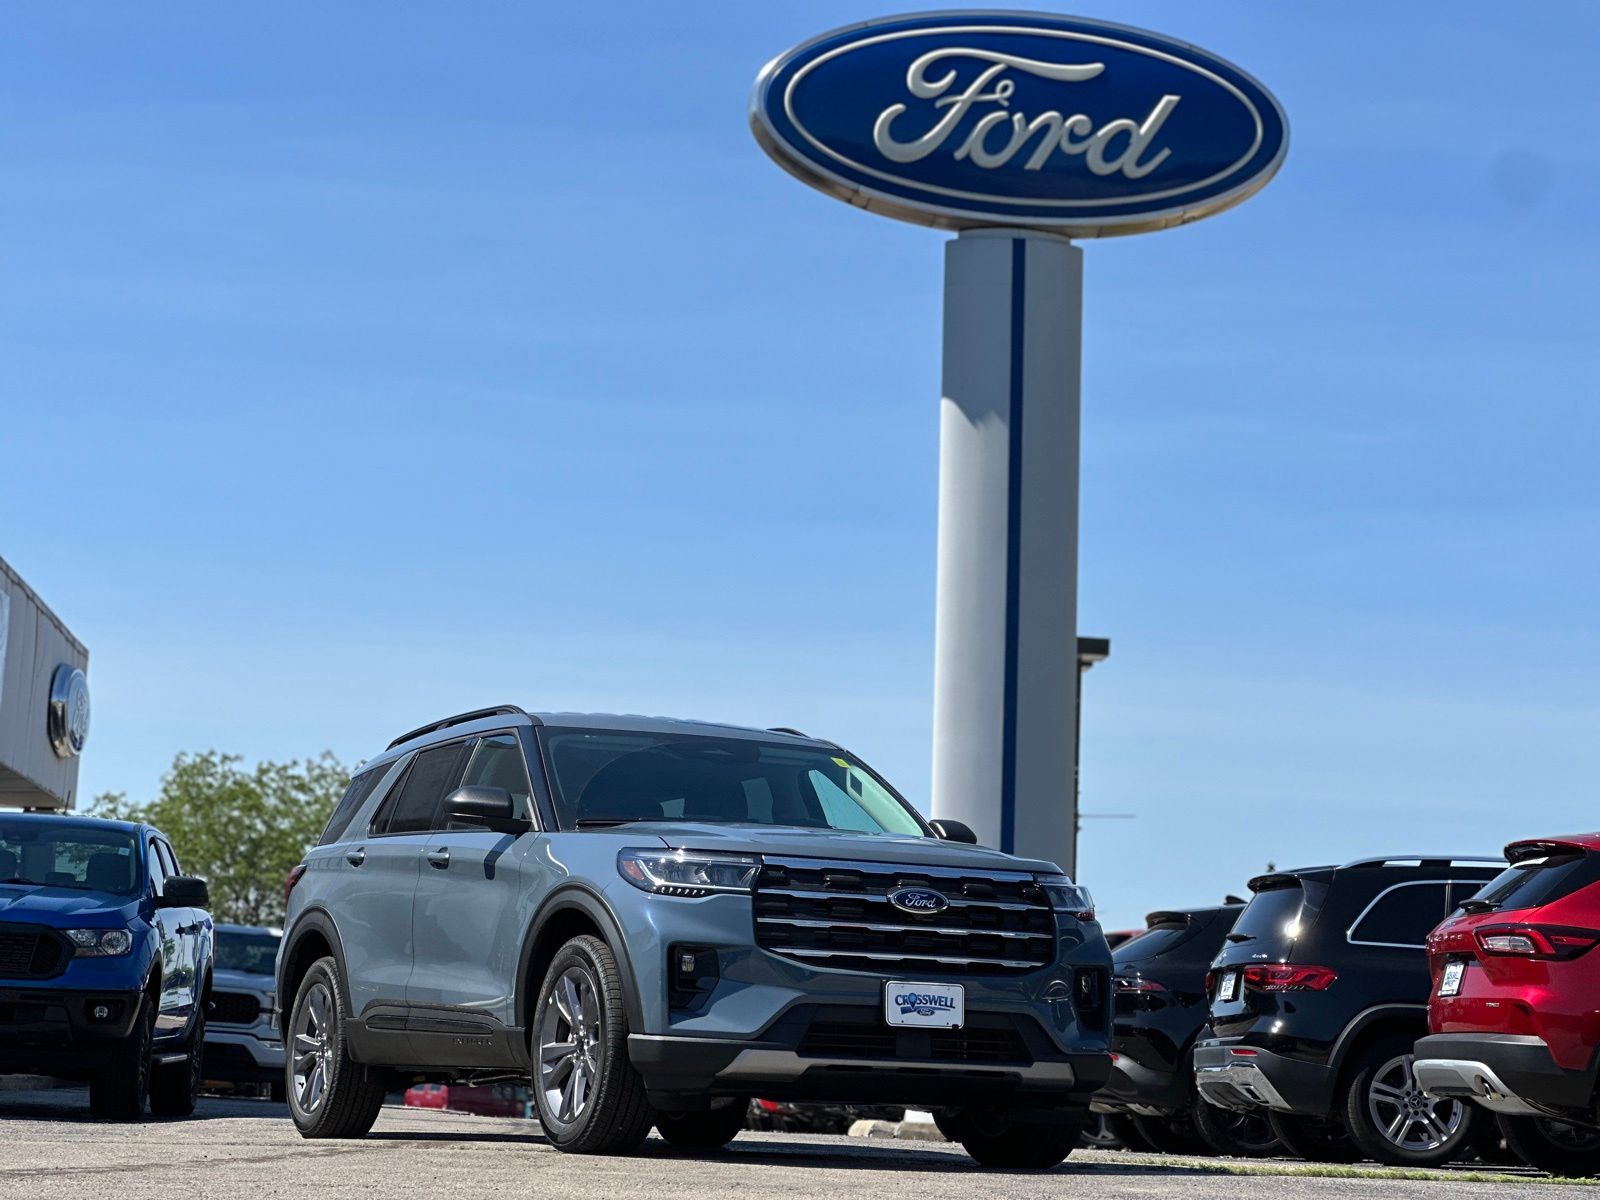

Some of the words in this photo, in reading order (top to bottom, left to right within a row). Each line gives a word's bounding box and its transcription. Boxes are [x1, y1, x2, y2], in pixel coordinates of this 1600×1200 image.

[873, 47, 1181, 179] Ford
[905, 892, 936, 908] Ford
[894, 993, 956, 1009] CROSSWELL
